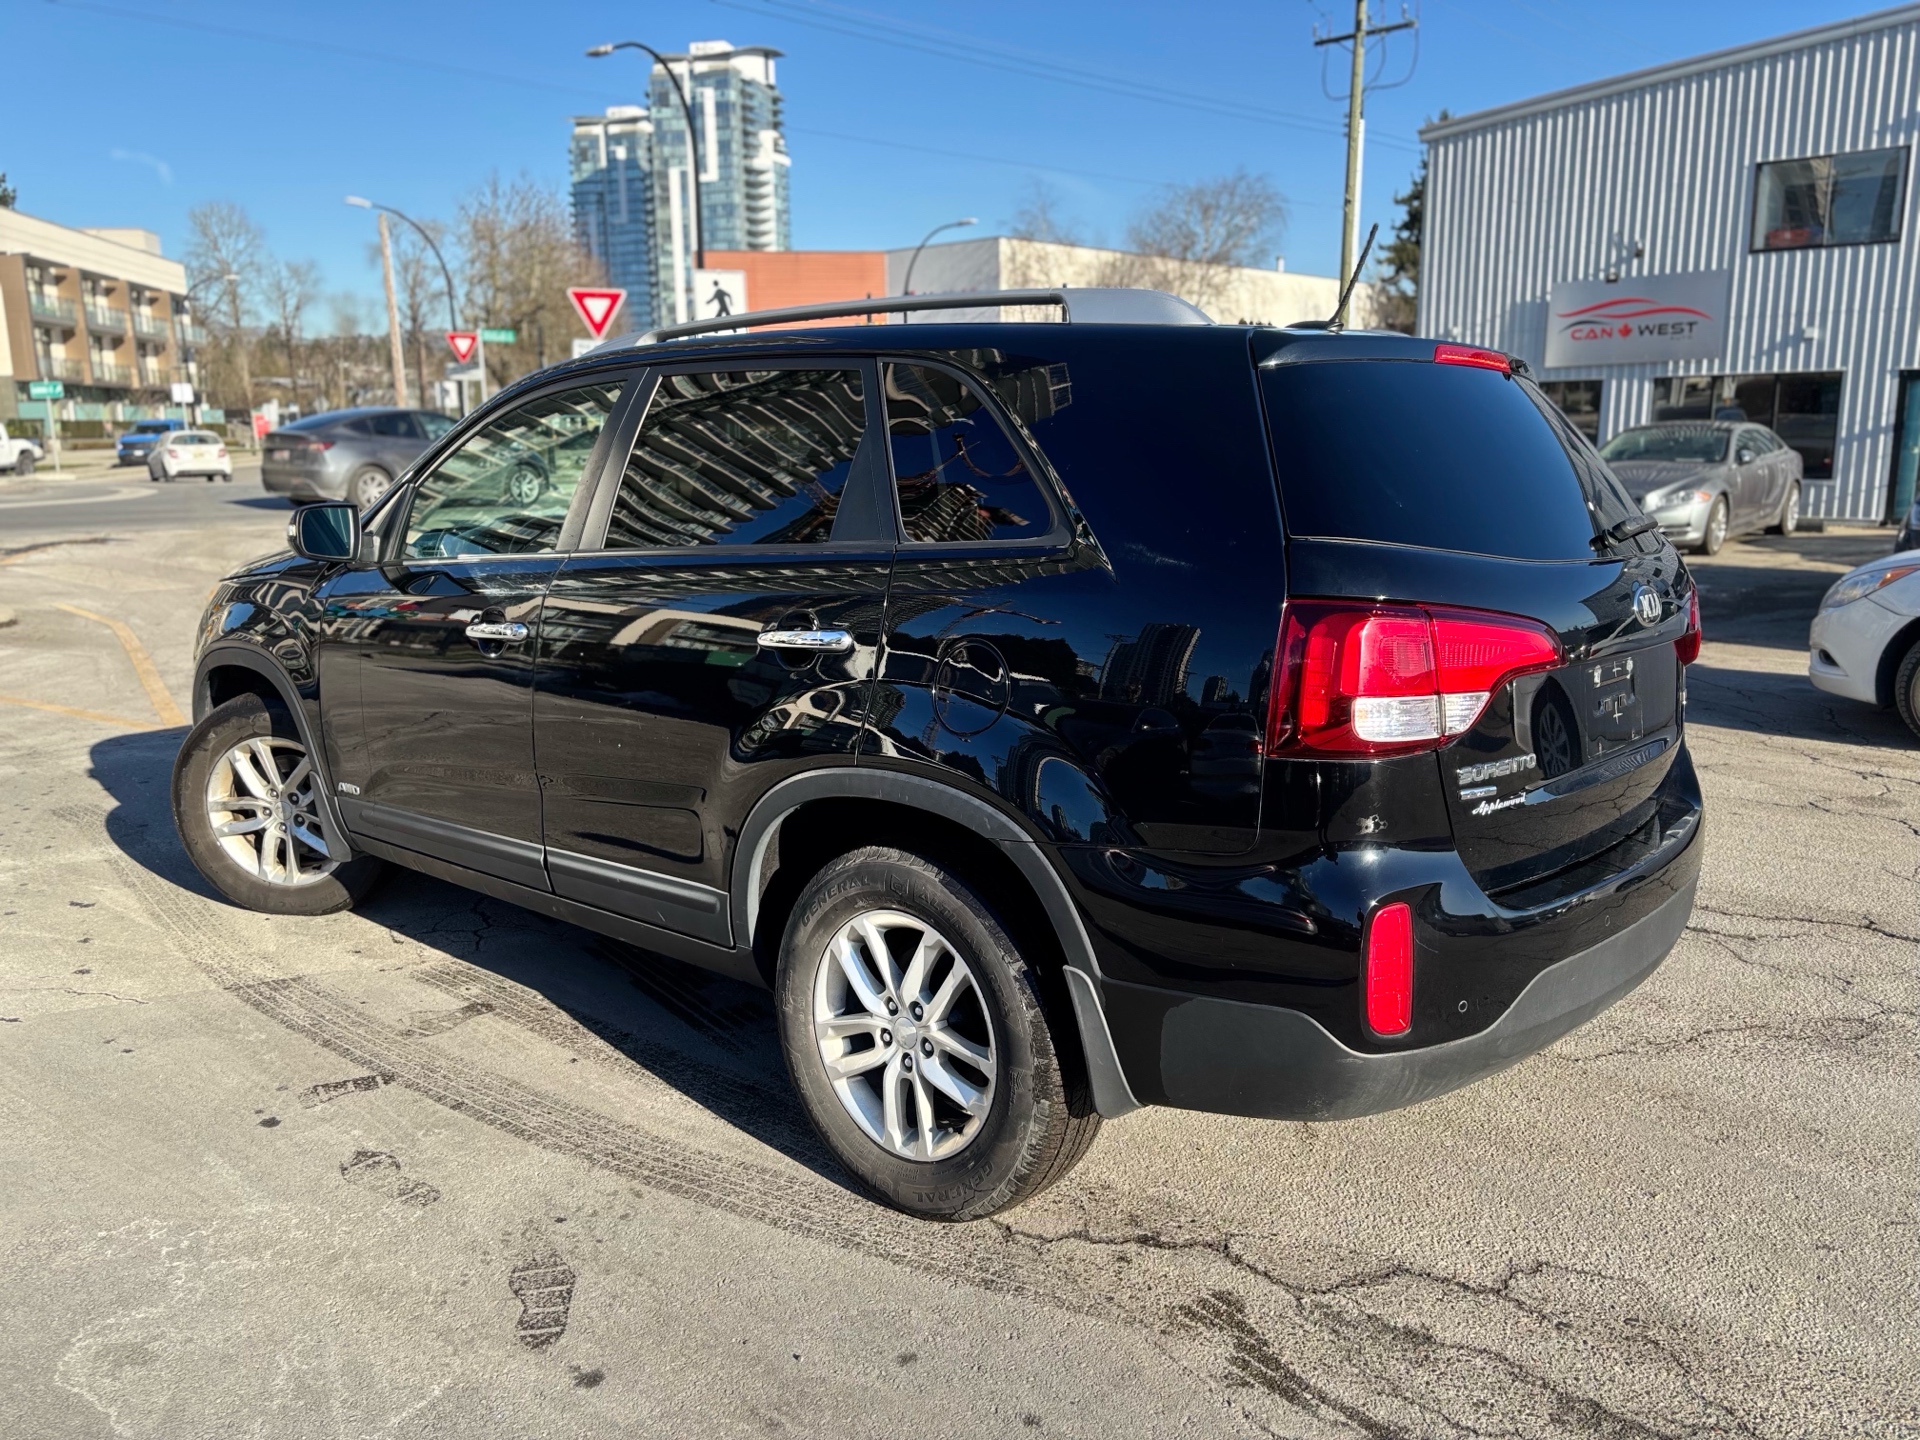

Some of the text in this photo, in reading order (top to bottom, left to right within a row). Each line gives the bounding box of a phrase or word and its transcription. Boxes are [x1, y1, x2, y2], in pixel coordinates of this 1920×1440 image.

[1569, 320, 1699, 341] CAN WEST
[1639, 593, 1661, 618] KIA
[1457, 752, 1537, 785] SORENTO
[338, 781, 360, 796] AWD
[1471, 791, 1527, 816] Applewood
[801, 874, 872, 928] GENERAL
[912, 1160, 994, 1204] GENERAL
